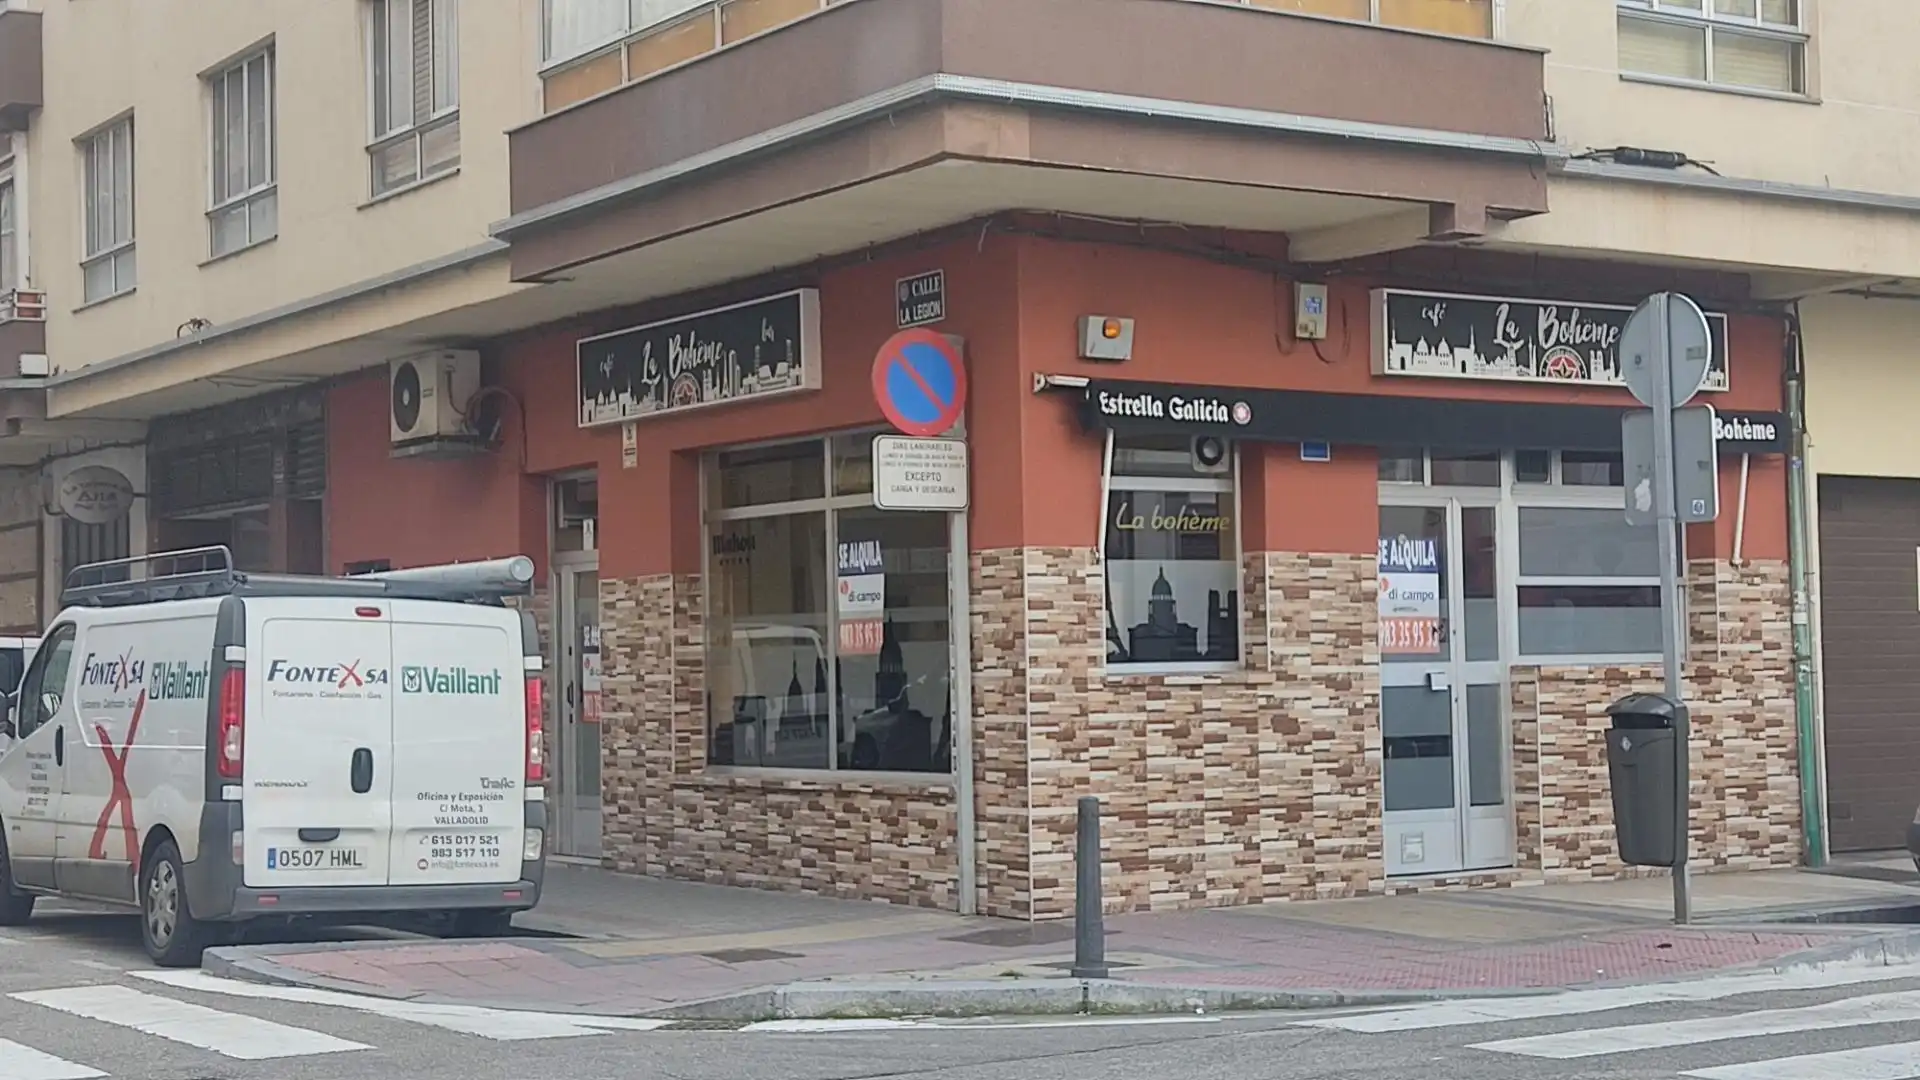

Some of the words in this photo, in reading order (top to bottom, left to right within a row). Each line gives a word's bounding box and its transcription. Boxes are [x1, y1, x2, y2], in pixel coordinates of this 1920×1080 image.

[912, 276, 941, 296] CALLE
[900, 307, 911, 324] LA
[1493, 303, 1524, 350] La
[641, 340, 661, 385] La
[1099, 391, 1164, 417] Estrella
[1168, 396, 1229, 422] Galicia
[1715, 417, 1776, 440] Bohème
[904, 471, 942, 481] EXCEPTO
[1116, 502, 1145, 529] La
[1151, 504, 1230, 530] bohème
[839, 543, 848, 569] SE
[849, 540, 883, 573] ALQUILA
[1389, 539, 1437, 572] ALQUILA
[1388, 588, 1398, 600] di
[1402, 590, 1434, 602] campo
[1399, 619, 1410, 648] 35
[1412, 619, 1424, 648] 95
[161, 661, 208, 699] Vaillant
[423, 666, 502, 695] Vaillant
[480, 777, 516, 789] Trafic
[418, 792, 449, 801] Oficina
[451, 795, 457, 803] y
[434, 816, 489, 825] VALLADOLID
[431, 835, 453, 845] 615
[455, 835, 477, 845] 017
[479, 835, 500, 845] 521
[279, 850, 325, 868] 0507
[330, 850, 363, 867] HML
[431, 848, 453, 858] 983
[455, 848, 477, 858] 517
[479, 848, 500, 858] 110
